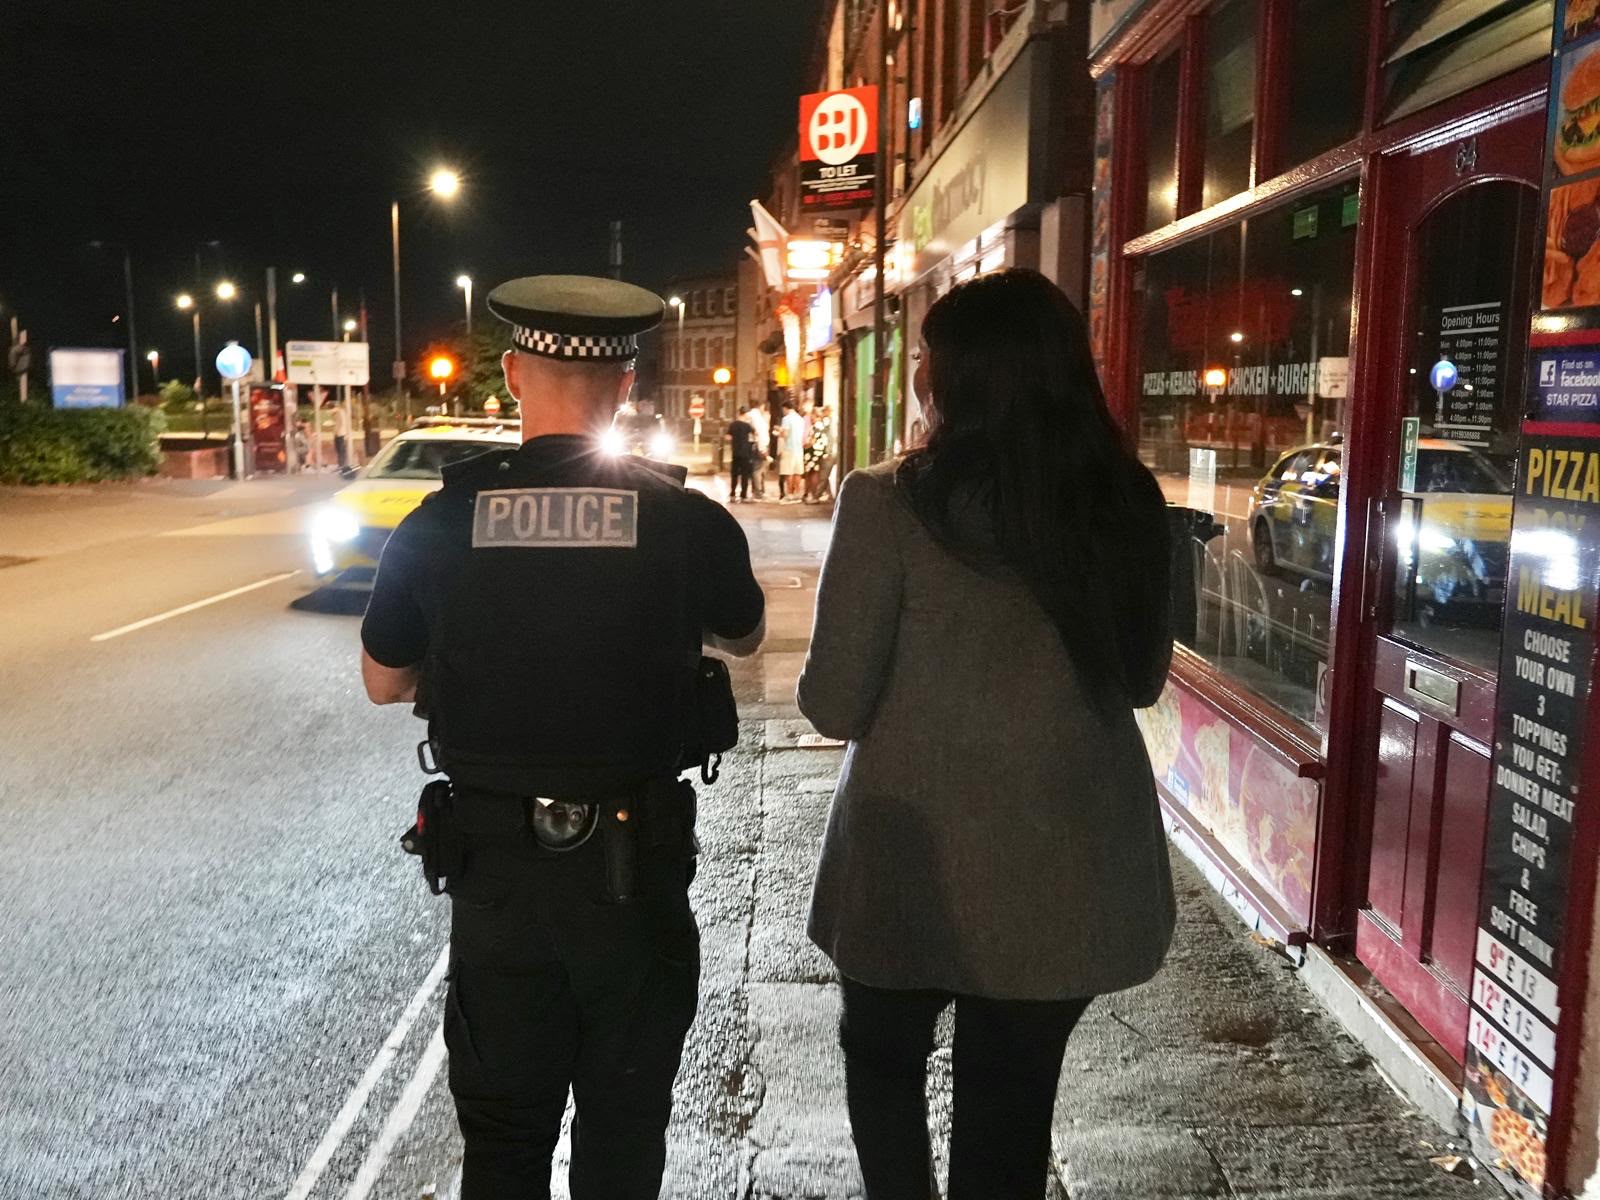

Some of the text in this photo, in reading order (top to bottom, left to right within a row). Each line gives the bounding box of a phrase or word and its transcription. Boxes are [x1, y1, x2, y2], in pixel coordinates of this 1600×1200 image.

[816, 107, 859, 151] BBJ
[818, 164, 859, 178] TO LET
[1441, 312, 1500, 329] Opening Hours
[1168, 370, 1197, 396] KEBABS
[1227, 365, 1270, 396] CHICKEN
[1560, 371, 1600, 387] faceboo
[1561, 360, 1575, 369] Find
[1576, 361, 1584, 369] us
[1546, 393, 1598, 406] STAR PIZZA
[1526, 448, 1600, 503] PIZZA
[485, 494, 623, 539] POLICE
[1517, 565, 1586, 629] MEAL
[1524, 628, 1571, 663] CHOOSE
[1515, 655, 1576, 697] YOUR OWN
[1536, 694, 1546, 717] 3
[1512, 713, 1568, 757] TOPPINGS
[1512, 742, 1562, 786] YOU GET:
[1496, 764, 1575, 823] DONNER MEAT
[1511, 802, 1550, 845] SALAD,
[1512, 831, 1546, 870] CHIPS
[1520, 867, 1530, 891] &
[1490, 905, 1518, 940] SOFT
[1509, 888, 1538, 926] FREE
